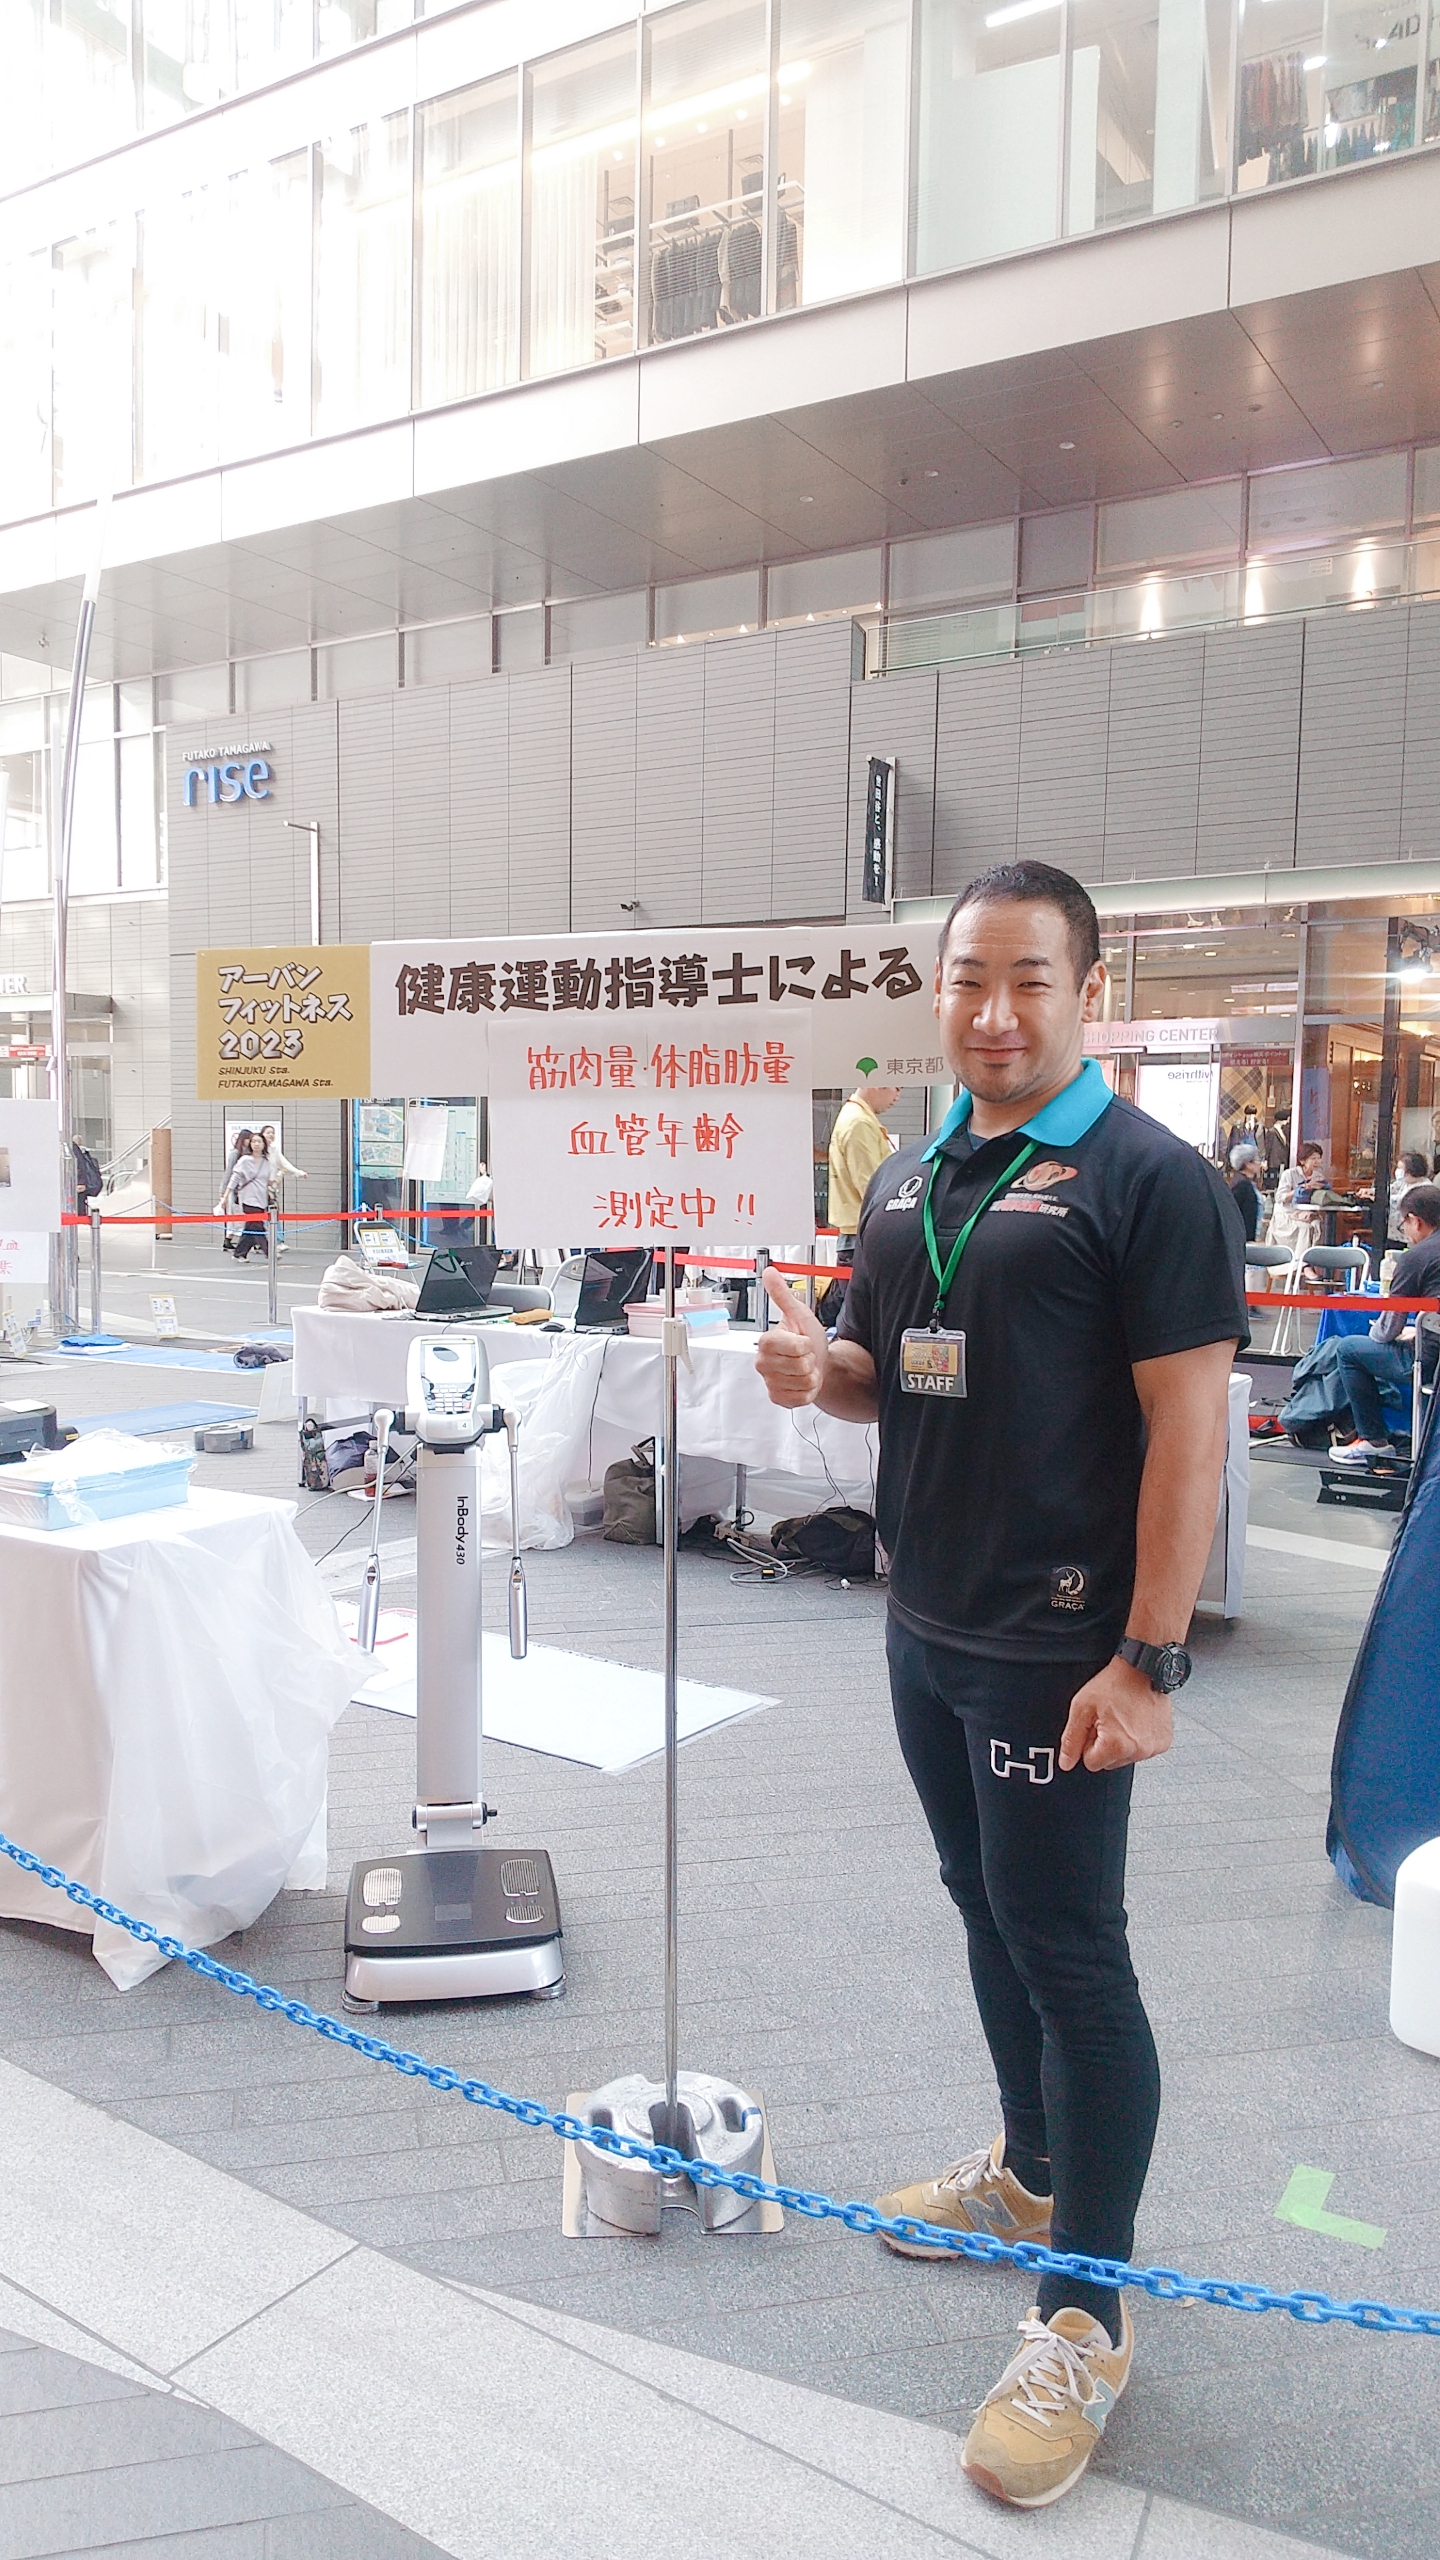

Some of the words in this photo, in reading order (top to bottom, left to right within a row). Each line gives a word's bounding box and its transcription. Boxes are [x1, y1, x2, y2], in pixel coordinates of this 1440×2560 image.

[182, 748, 215, 761] FUTAKO
[218, 741, 271, 757] TAMAGAWA
[182, 758, 270, 806] rise
[218, 961, 323, 994] アーバン
[395, 947, 923, 1015] 健康運動指導士による
[218, 992, 353, 1025] フィットネス
[218, 1028, 304, 1060] 2023
[1084, 1029, 1155, 1045] SHOPPING
[1158, 1027, 1219, 1042] CENTER
[218, 1066, 267, 1076] SHINJUKU
[268, 1066, 291, 1075] Sta.
[886, 1056, 944, 1076] 東京都
[218, 1078, 310, 1089] FUTAKOTAMAGAWA
[312, 1077, 334, 1087] Sta.
[568, 1112, 744, 1159] 血管年齢
[593, 1186, 716, 1229] 測定中
[907, 1373, 955, 1392] STAFF
[457, 1495, 469, 1543] InBody
[455, 1544, 467, 1565] 430
[1050, 1600, 1085, 1612] GRAÇA
